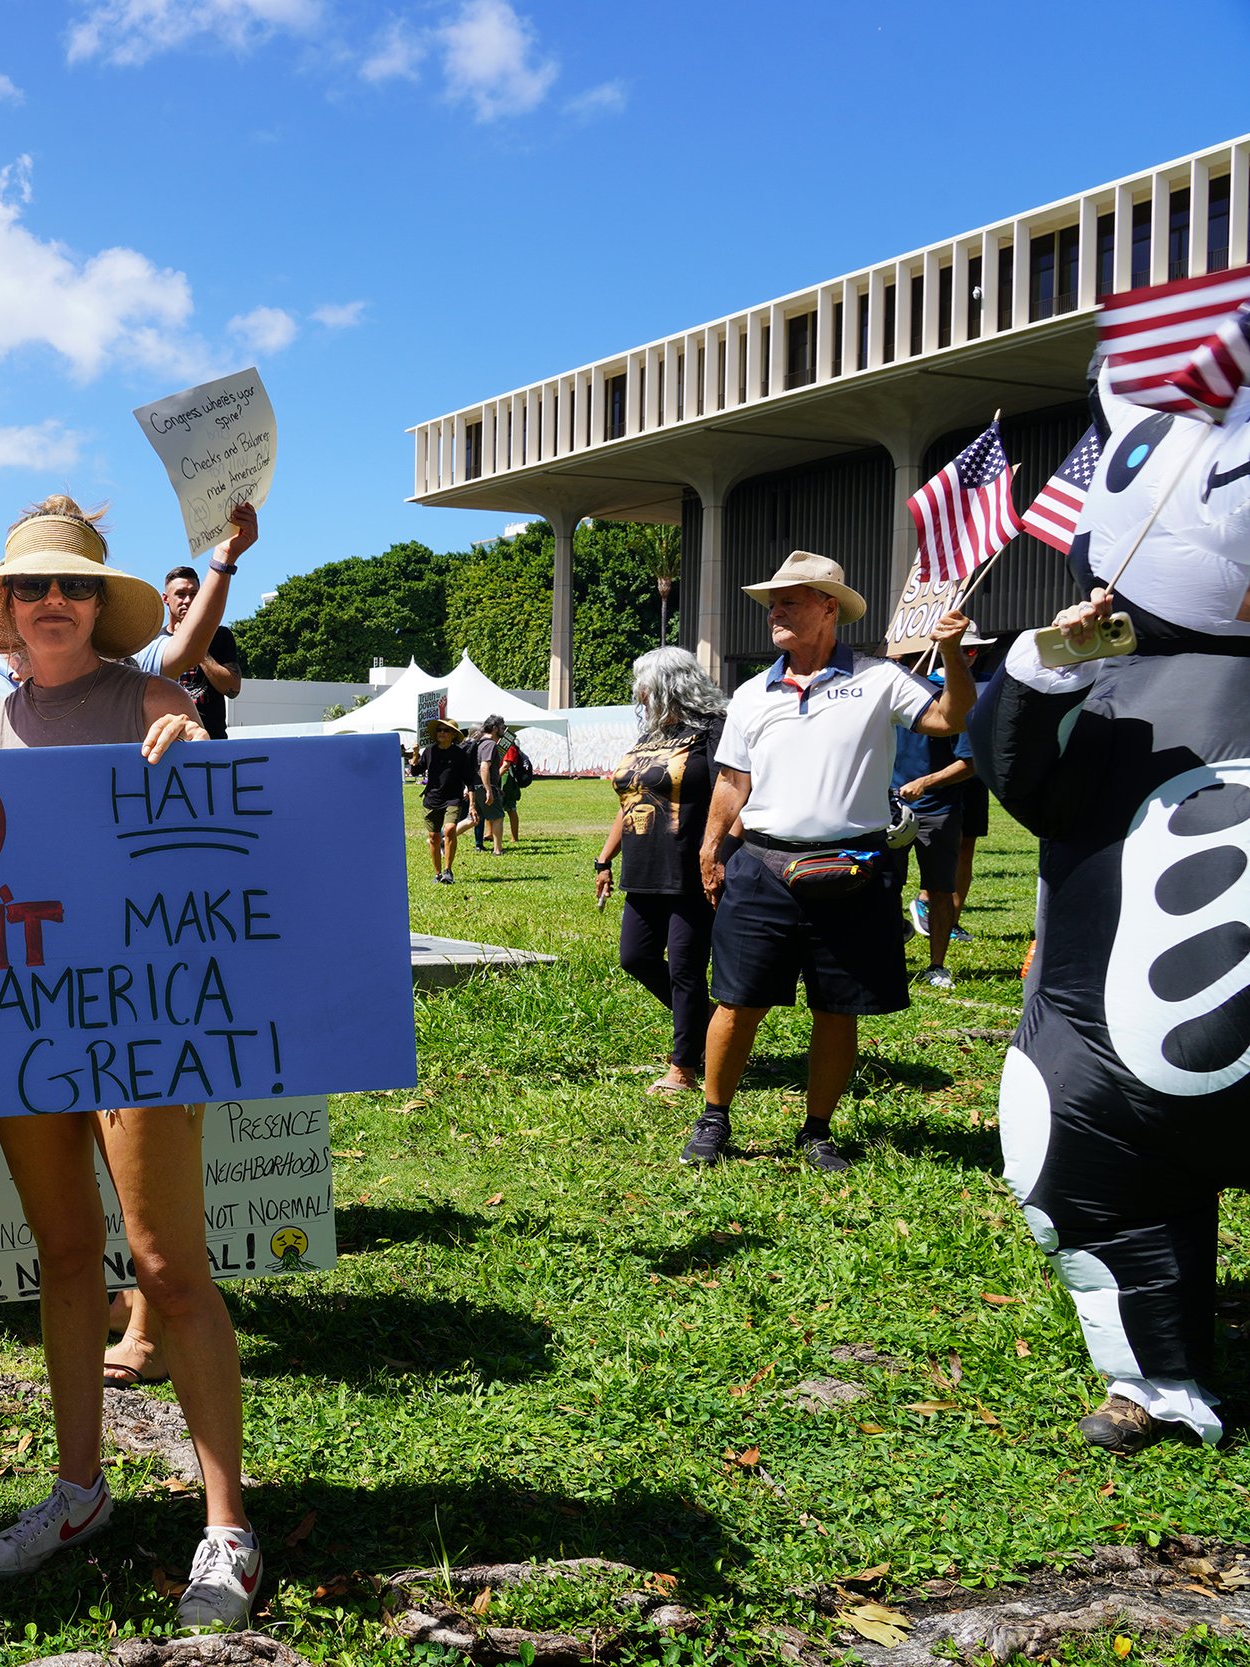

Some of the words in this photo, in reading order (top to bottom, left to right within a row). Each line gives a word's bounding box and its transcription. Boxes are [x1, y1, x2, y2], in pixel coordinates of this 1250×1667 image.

[149, 408, 203, 435] Congress
[201, 389, 237, 414] where's
[236, 386, 255, 406] your
[214, 403, 243, 431] spine?
[181, 449, 222, 480] Checks
[224, 441, 239, 460] and
[418, 692, 436, 703] Truth
[827, 688, 862, 700] usa
[111, 755, 274, 825] HATE
[124, 888, 282, 948] MAKE
[17, 1020, 286, 1116] GREAT!
[216, 1101, 323, 1144] PRESENCE
[205, 1146, 330, 1188] NEIGHBORHOODS
[0, 1221, 33, 1249] NO
[205, 1202, 240, 1230] NOT
[248, 1184, 332, 1227] NORMAL!
